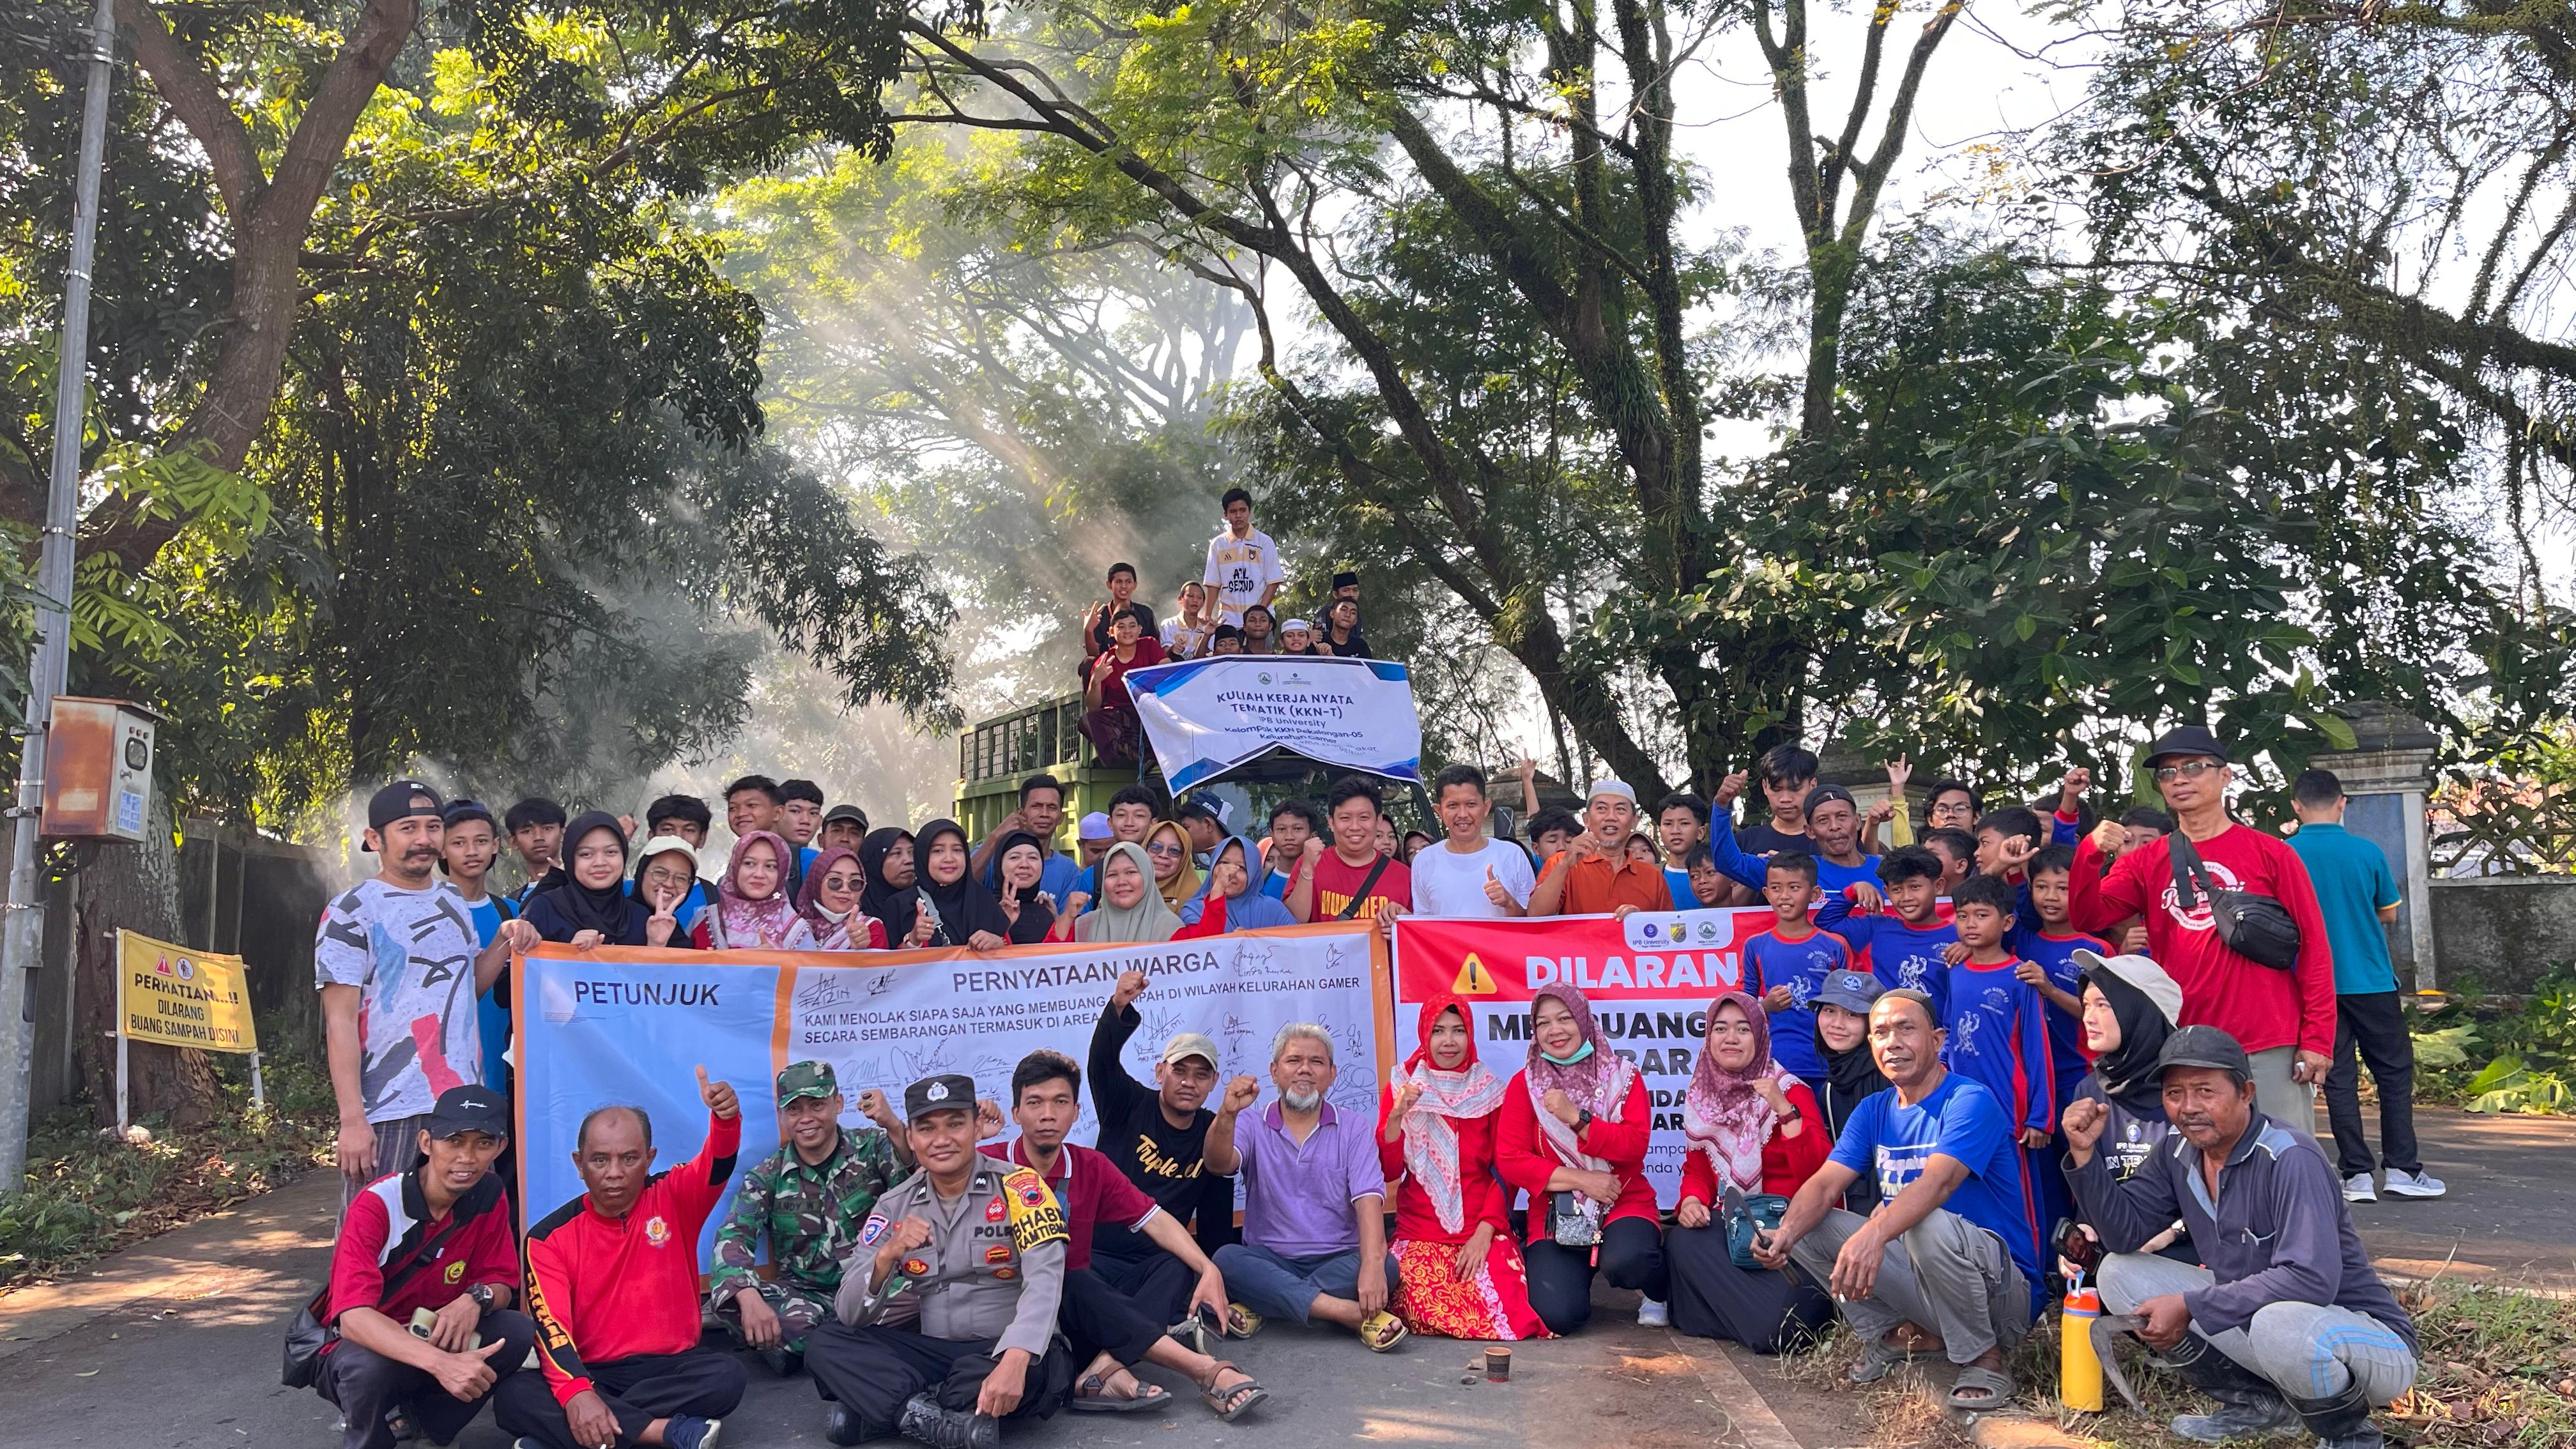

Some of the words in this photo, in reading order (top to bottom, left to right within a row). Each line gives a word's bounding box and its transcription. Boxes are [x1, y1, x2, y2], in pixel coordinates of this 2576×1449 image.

[1216, 691, 1264, 703] KULIAH
[1267, 693, 1308, 703] KERJA
[1311, 694, 1354, 705] NYATA
[1230, 703, 1287, 715] TEMATIK
[1290, 705, 1342, 719] (KKN-T)
[1259, 716, 1273, 724] IPB
[1276, 717, 1326, 728] University
[1321, 890, 1388, 918] HUNRED
[953, 960, 1118, 992] PERNYATAAN
[1125, 951, 1220, 977] WARGA
[1526, 953, 1739, 989] DILARAN
[574, 981, 721, 1006] PETUNJUK
[805, 1014, 836, 1027] KAMI
[840, 1011, 906, 1025] MENOLAK
[909, 1008, 949, 1022] SIAPA
[952, 1006, 985, 1019] SAJA
[988, 1003, 1025, 1016] YANG
[1028, 995, 1106, 1014] MEMBUANG
[1168, 988, 1181, 999] DI
[1183, 982, 1236, 997] WILAYAH
[1238, 979, 1315, 992] KELURAHAN
[1318, 977, 1360, 989] GAMER
[158, 999, 204, 1021] DILARANG
[131, 1014, 162, 1034] BUANG
[165, 1020, 206, 1040] SAMPAH
[210, 1027, 239, 1043] DISINI
[804, 1031, 857, 1043] SECARA
[861, 1023, 966, 1041] SEMBARANGAN
[970, 1017, 1043, 1034] TERMASUK
[1047, 1016, 1060, 1028] DI
[1062, 1012, 1100, 1027] AREA
[1488, 1011, 1708, 1041] MEUANG
[974, 1225, 1013, 1238] POLR
